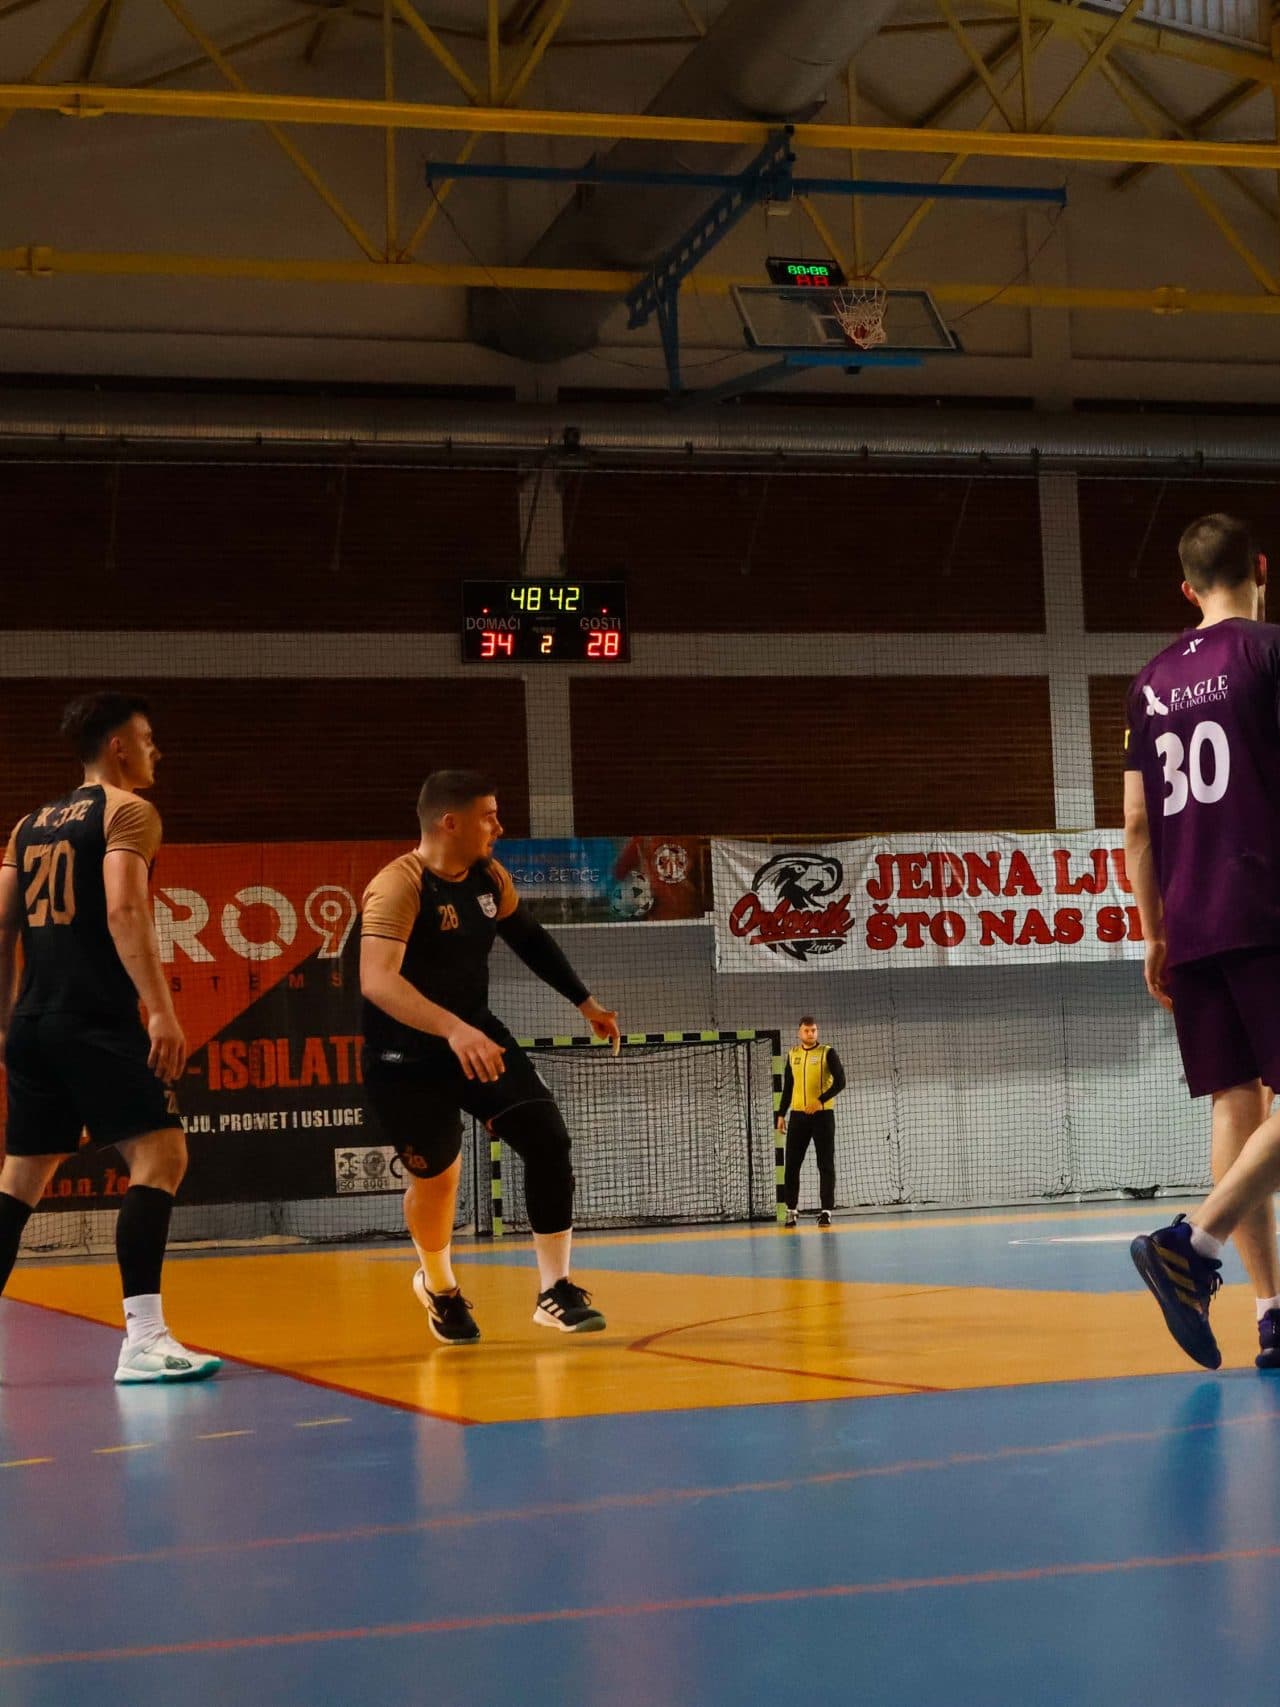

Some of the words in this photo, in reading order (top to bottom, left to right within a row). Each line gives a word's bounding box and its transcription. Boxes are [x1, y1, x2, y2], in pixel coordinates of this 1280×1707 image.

[511, 587, 541, 611] 48
[549, 587, 580, 611] 42
[580, 617, 621, 631] GOSTI
[481, 633, 513, 656] 34
[541, 635, 552, 653] 2
[587, 633, 619, 656] 28
[1170, 675, 1229, 703] EAGLE
[1170, 690, 1228, 712] TECHNOLOGY
[1155, 720, 1230, 817] 30
[23, 840, 76, 927] 20
[866, 851, 1042, 900] JEDNA
[153, 885, 357, 963] RO9
[438, 903, 459, 931] 28
[866, 903, 966, 950] ŠTO
[978, 907, 1085, 946] NAS
[219, 1112, 288, 1132] PROMET
[301, 1107, 363, 1129] USLUGE
